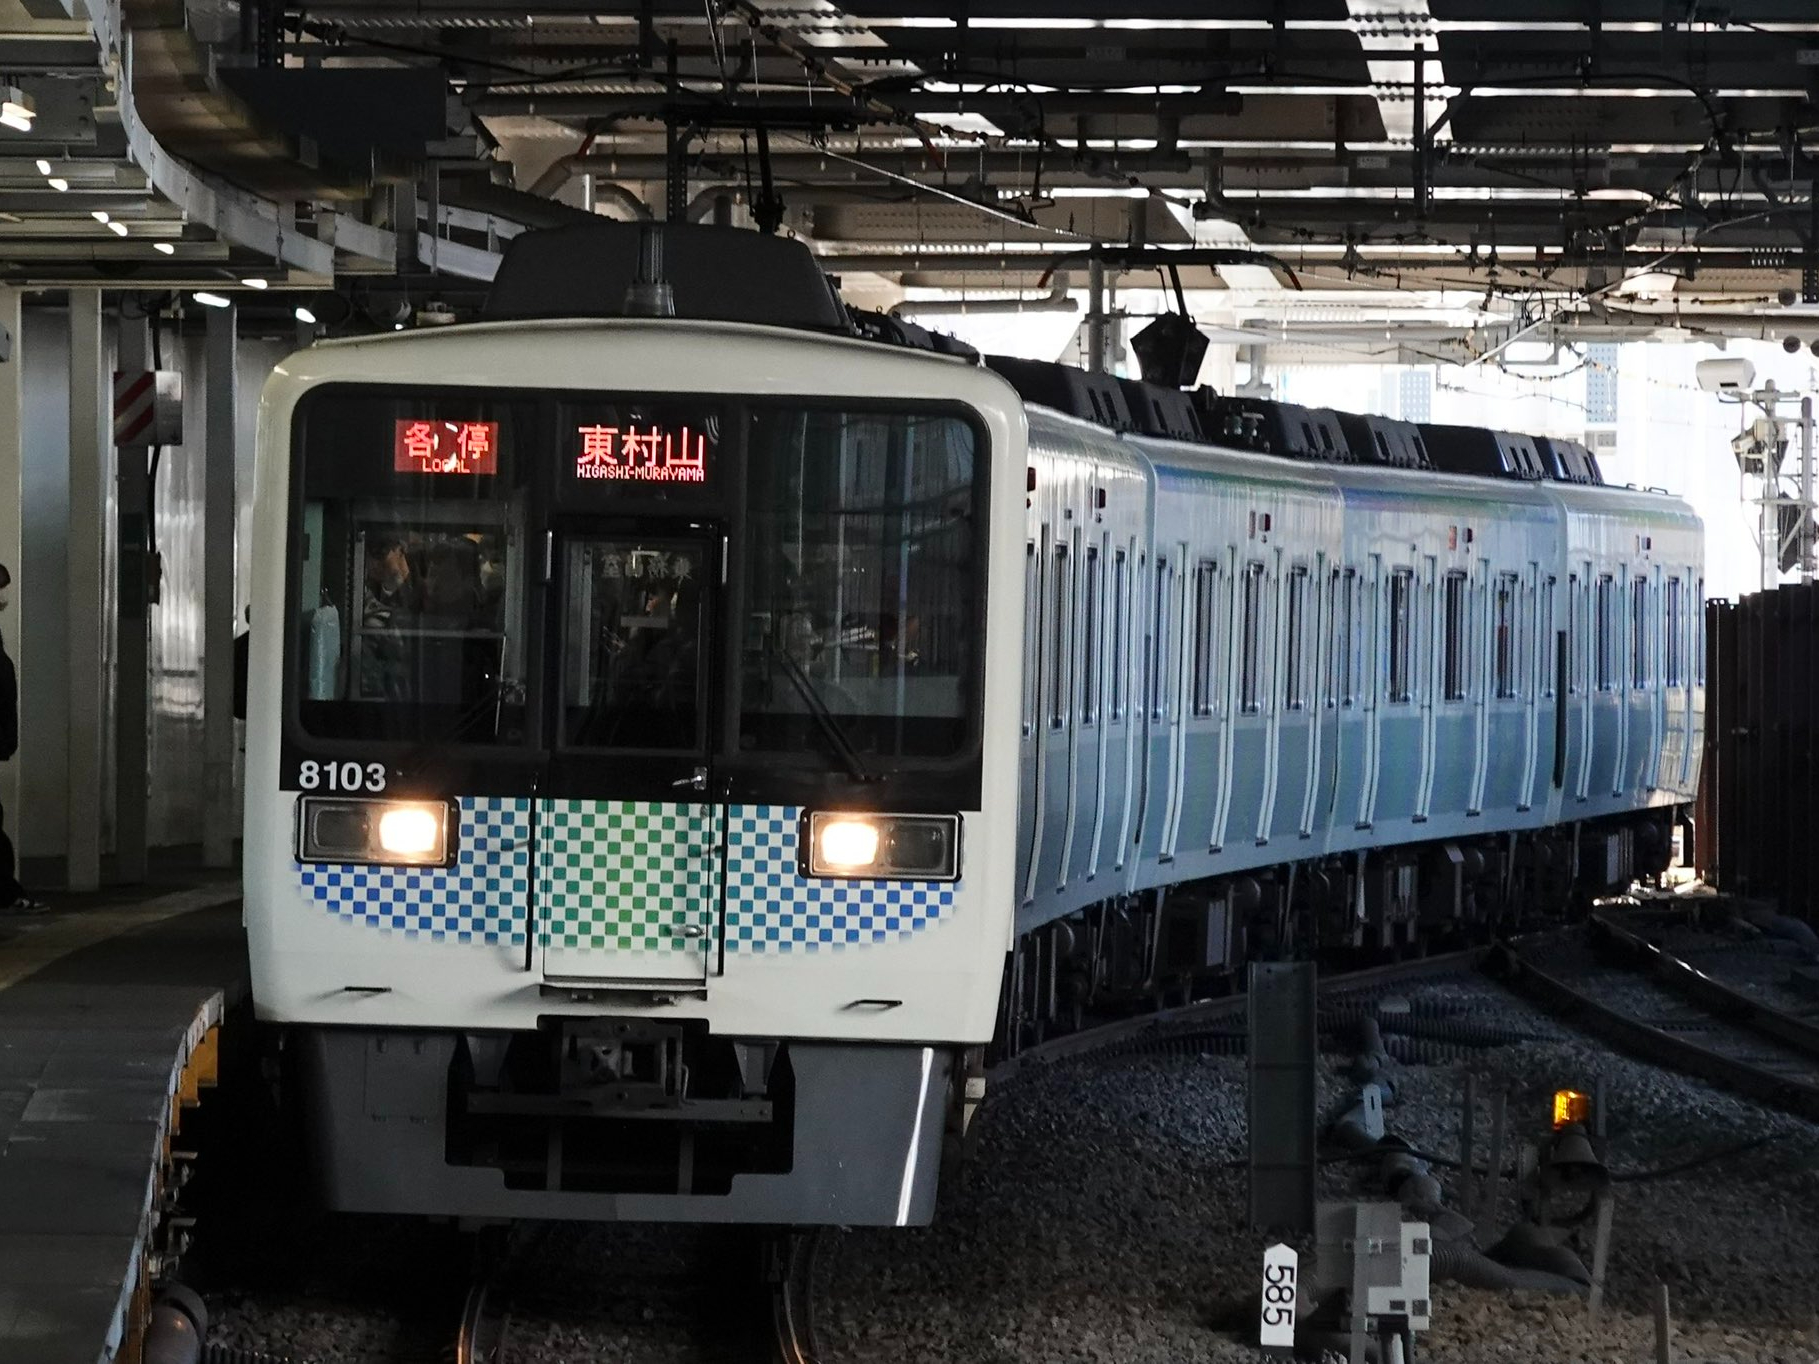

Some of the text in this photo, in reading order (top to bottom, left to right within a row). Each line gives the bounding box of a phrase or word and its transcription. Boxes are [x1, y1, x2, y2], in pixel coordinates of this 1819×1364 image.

[404, 422, 489, 459] 各停
[577, 424, 704, 467] 東村山
[422, 457, 470, 473] LOCAL
[576, 463, 705, 482] HIGASHI-MURAYAMA
[299, 760, 387, 792] 8103
[1263, 1263, 1295, 1326] 585
